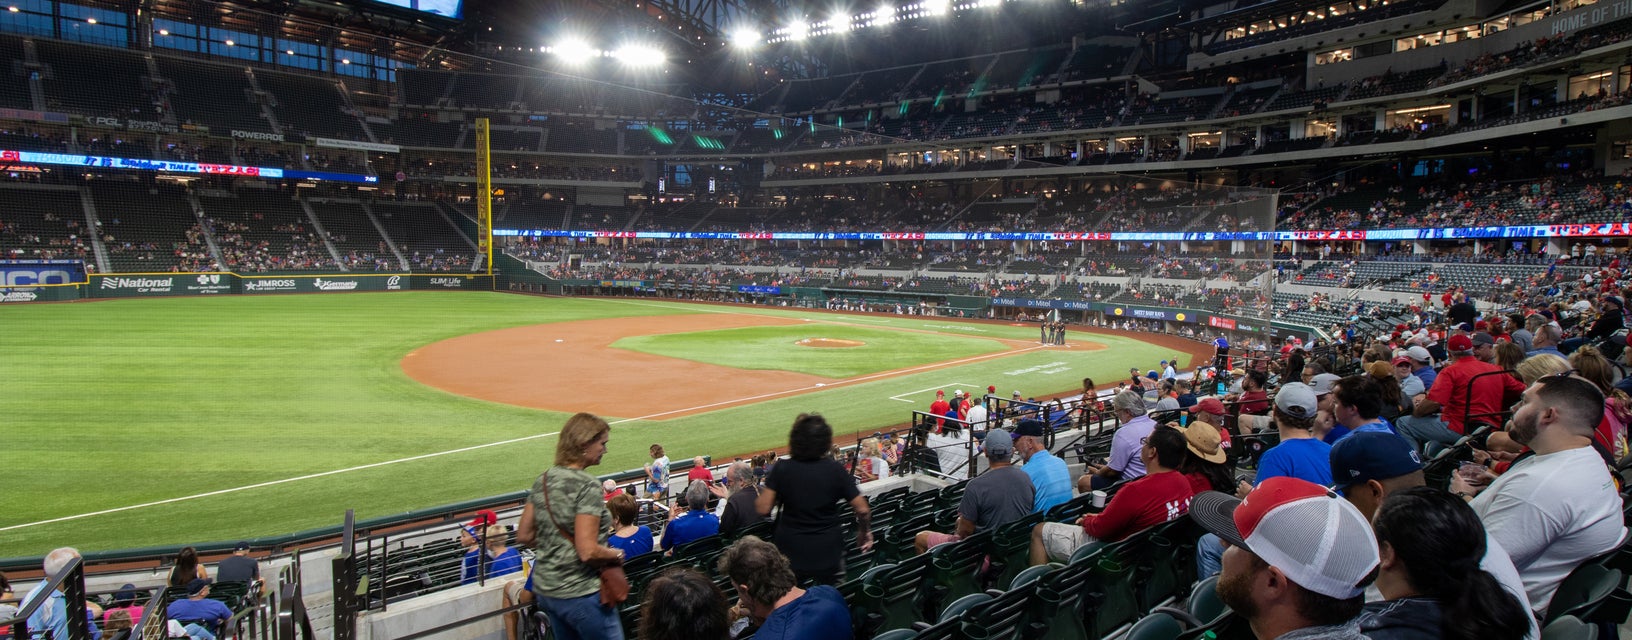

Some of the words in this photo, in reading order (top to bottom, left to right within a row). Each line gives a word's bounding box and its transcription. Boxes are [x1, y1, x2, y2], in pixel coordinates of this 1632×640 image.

[1552, 12, 1587, 35] HOME
[1592, 7, 1608, 24] OF
[232, 130, 284, 141] POWERADE
[1508, 226, 1534, 236] TIME
[1549, 223, 1632, 237] TEXA
[118, 277, 172, 288] National
[1001, 298, 1015, 306] Mitel
